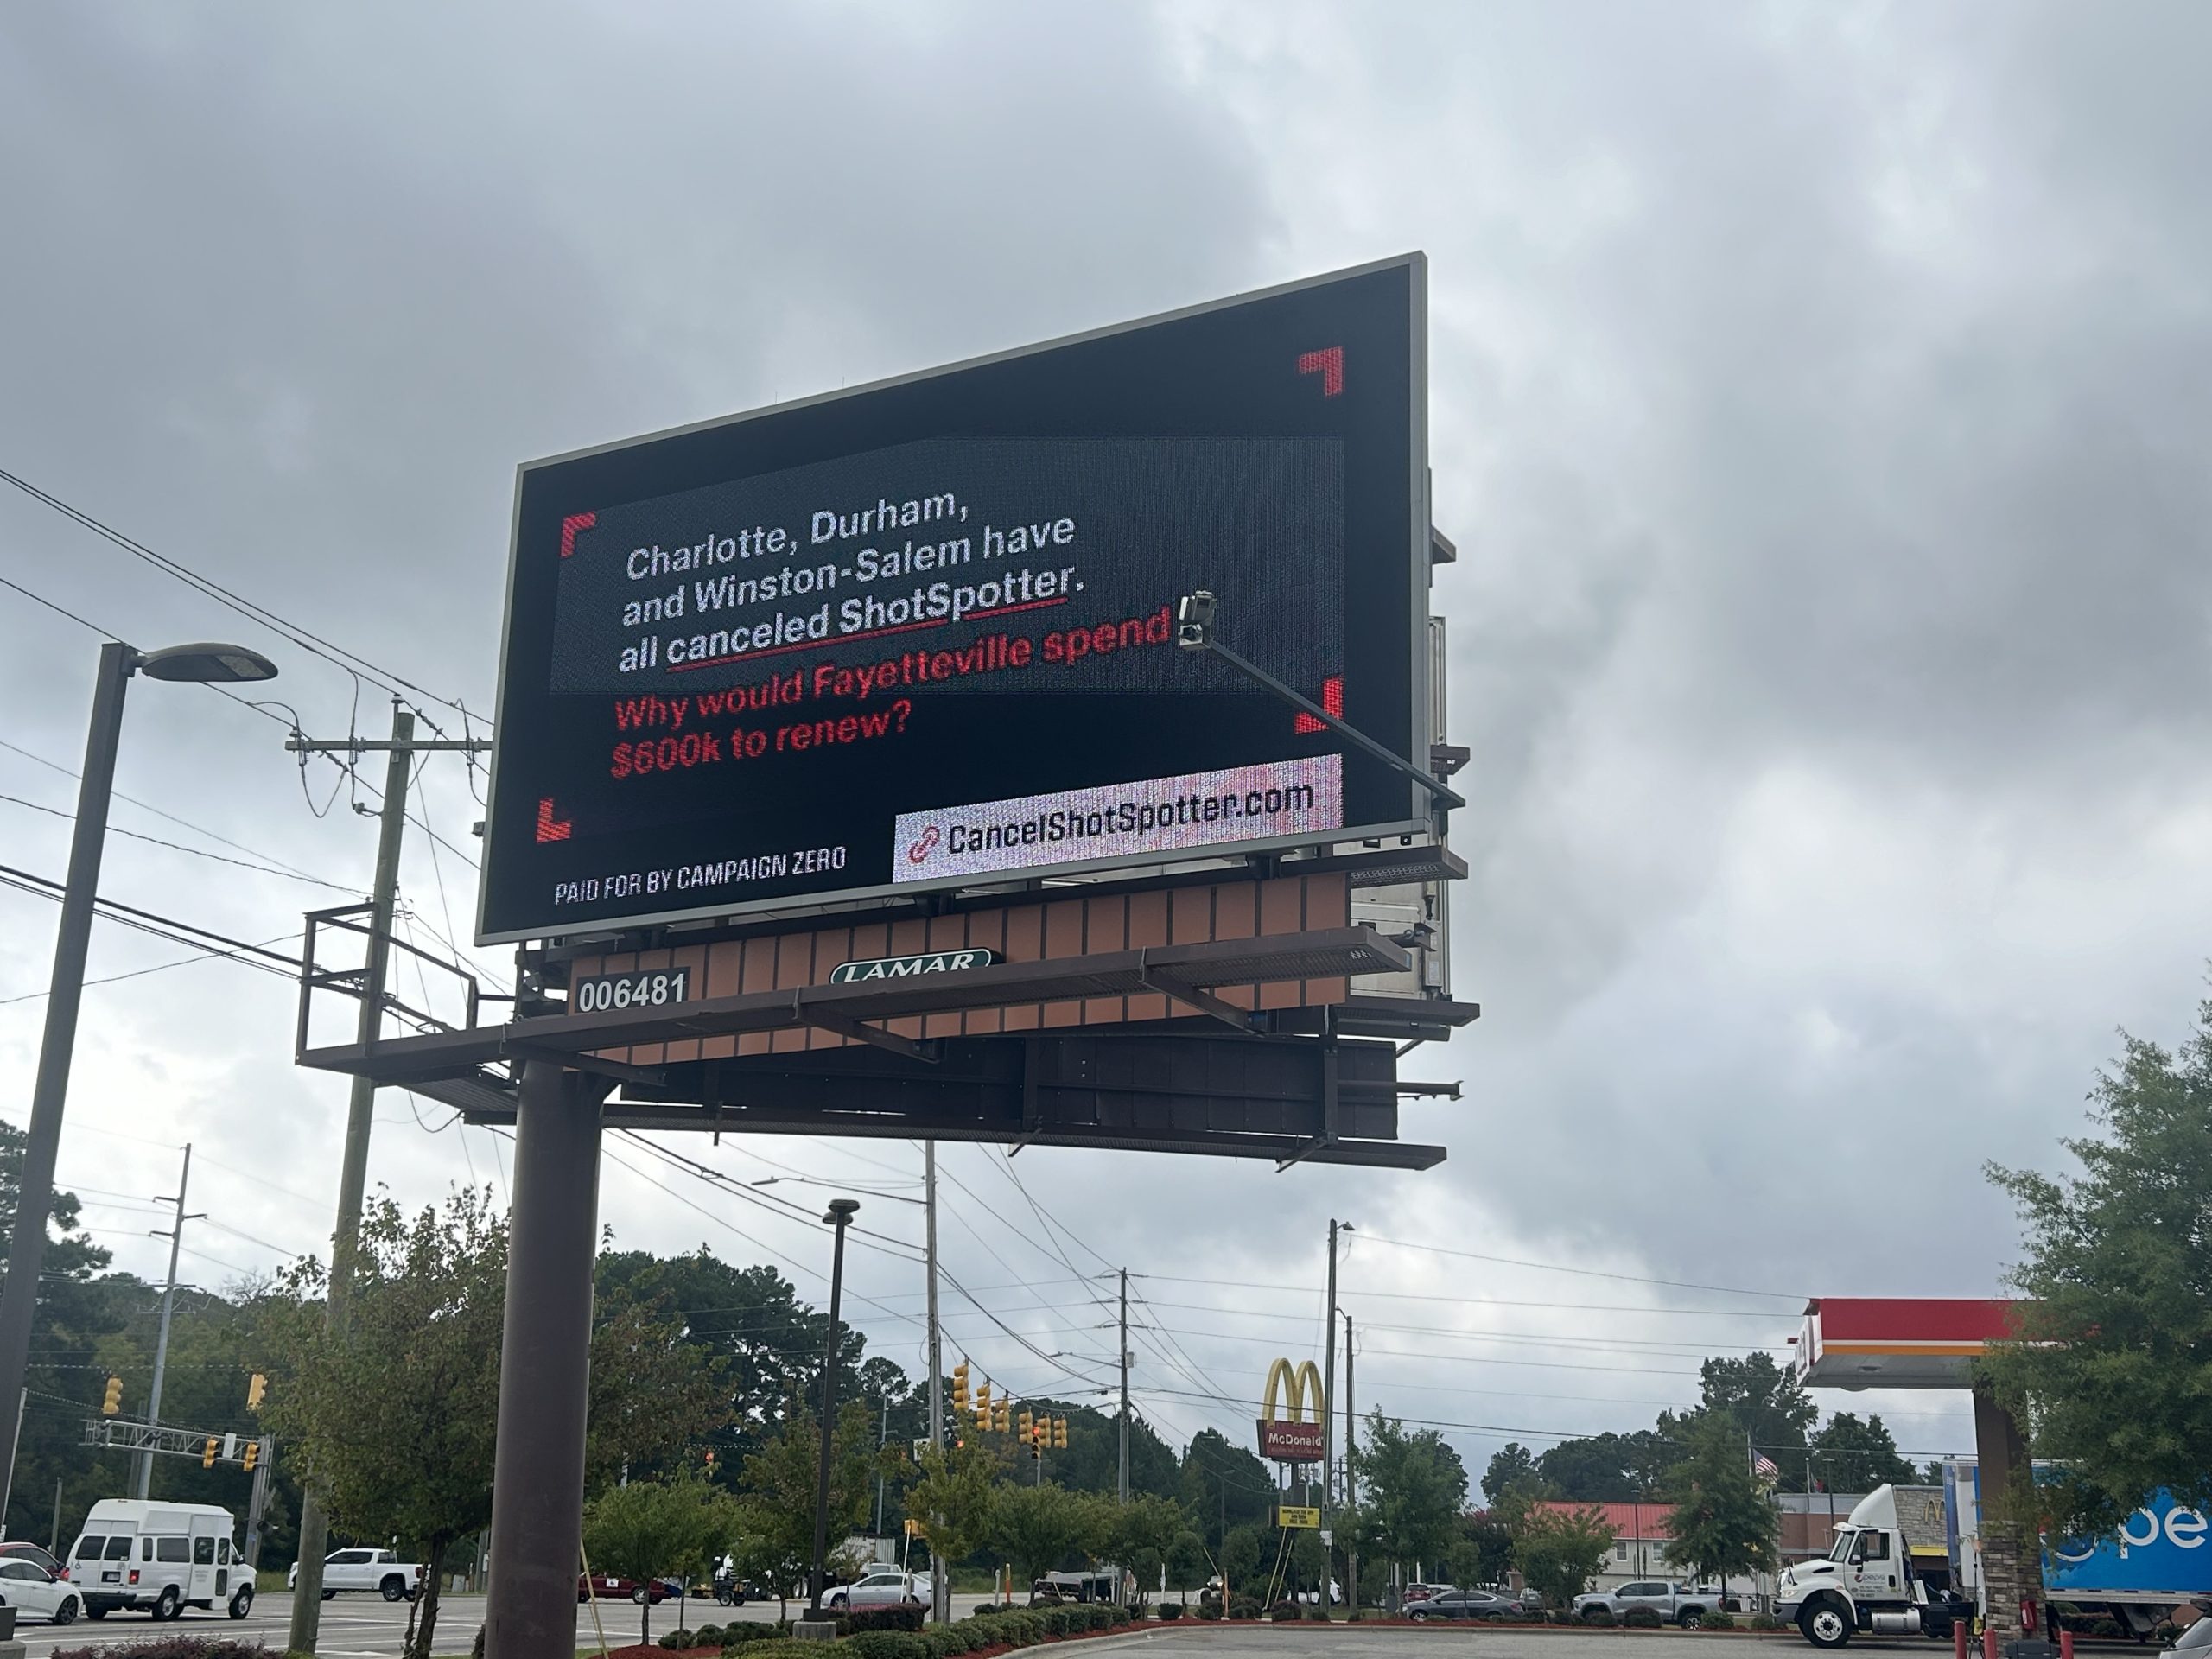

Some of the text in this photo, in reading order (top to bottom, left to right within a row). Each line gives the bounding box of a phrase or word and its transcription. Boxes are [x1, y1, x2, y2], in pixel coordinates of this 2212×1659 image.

[622, 517, 1075, 628] and Winston-Salem have
[626, 492, 969, 581] Charlotte, Durham,
[620, 565, 1084, 673] all canceled ShotSpotter.
[615, 607, 1171, 731] Why would Fayetteville spend
[611, 700, 912, 779] $600k to renew?
[950, 784, 1313, 854] CancelShotSpotter.com
[555, 846, 846, 905] PAID FOR BY CAMPAIGN ZERO
[578, 973, 685, 1013] 006481
[843, 953, 975, 983] LAMAR
[1268, 1433, 1325, 1447] McDonald'
